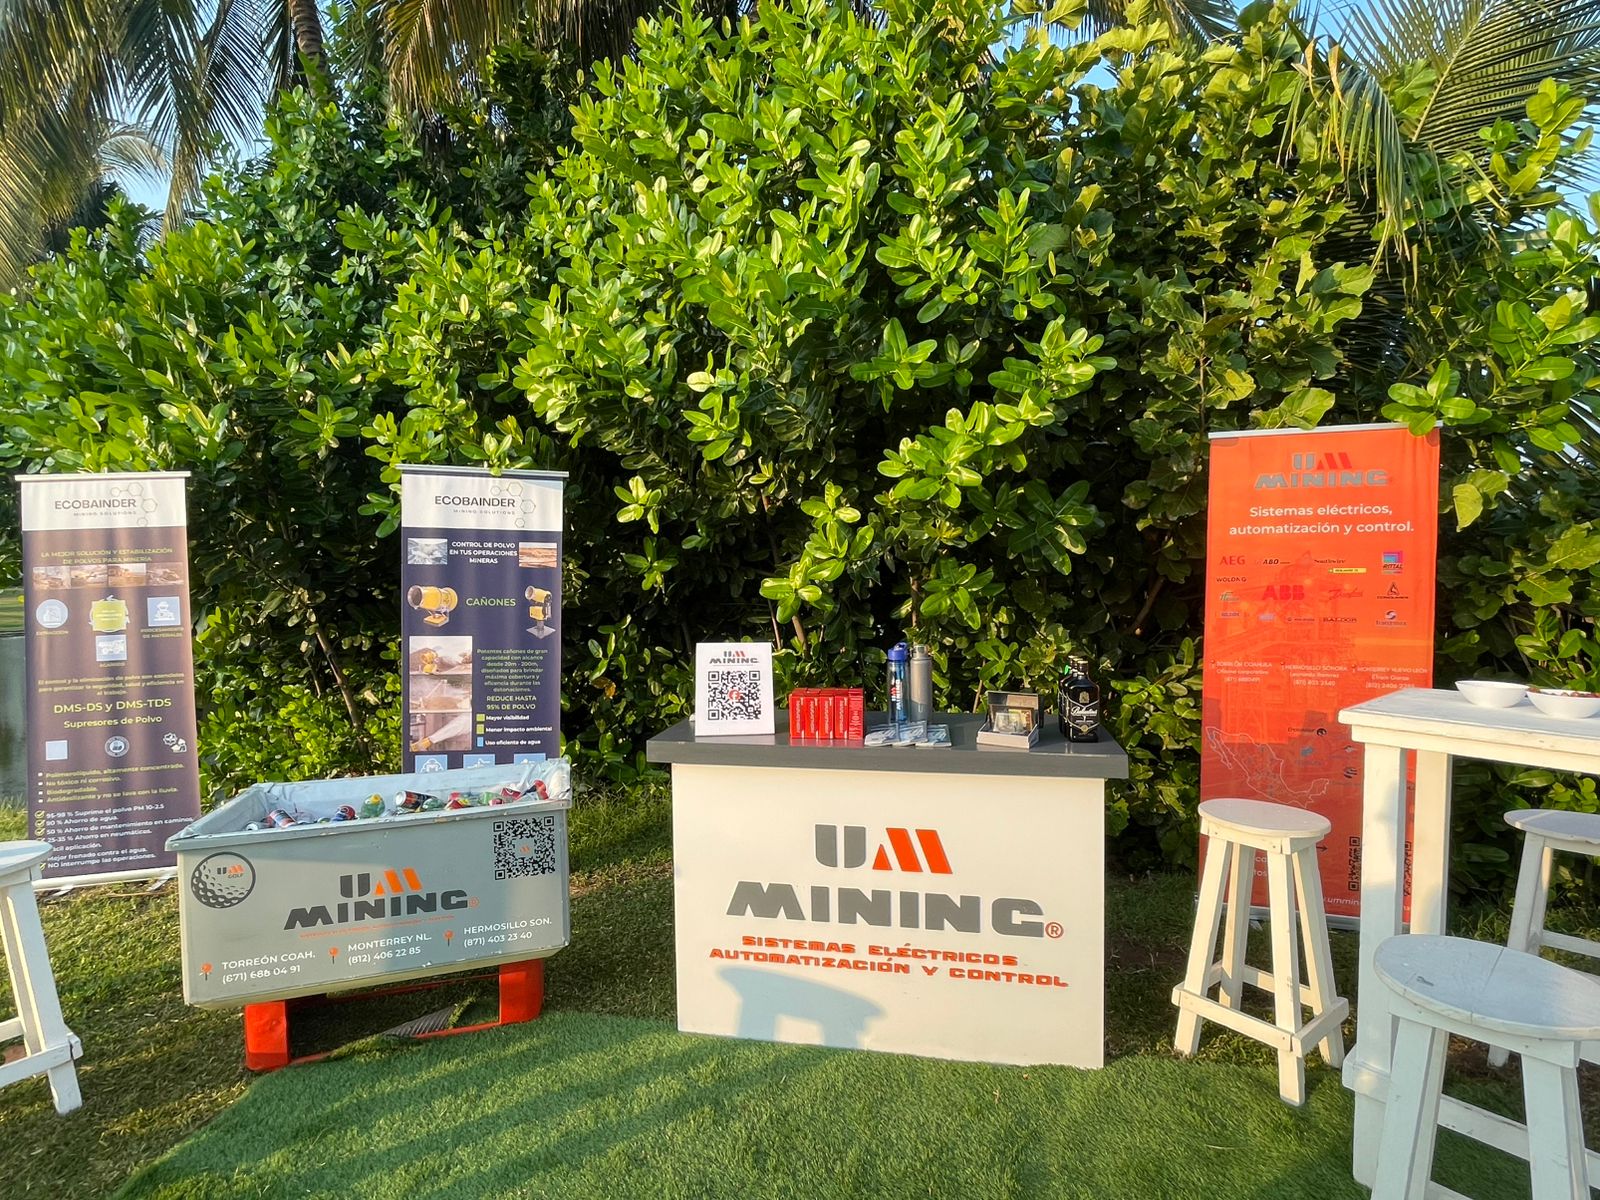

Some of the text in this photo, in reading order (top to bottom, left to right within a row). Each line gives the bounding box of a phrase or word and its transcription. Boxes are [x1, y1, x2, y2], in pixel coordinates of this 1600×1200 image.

[1255, 470, 1388, 489] MINING
[55, 498, 137, 510] ECOBAINDER
[435, 496, 515, 508] ECOBAINDER
[1250, 503, 1392, 517] Sistemas eléctricos,
[1229, 521, 1414, 535] automatización y control.
[1220, 555, 1246, 565] AEG
[1261, 585, 1305, 600] ABB
[466, 597, 516, 606] CAÑONES
[54, 698, 172, 714] DMS-DS y DMS-TDS
[64, 715, 162, 729] Supresores de Polvo
[75, 810, 104, 818] Suprime
[100, 821, 153, 830] mantenimiento
[110, 829, 152, 837] neumáticos.
[65, 843, 102, 852] aplicación.
[60, 858, 100, 867] interrumpe
[112, 853, 156, 862] operaciones.
[68, 851, 96, 860] frenado
[283, 890, 468, 930] MINING
[726, 880, 1044, 939] MINING
[464, 920, 527, 934] HERMOSILLO
[530, 917, 552, 926] SON.
[348, 933, 432, 952] MONTERREY NL.
[464, 931, 532, 948] (871) 403 23 40
[348, 946, 421, 965] (812) 406 22 85
[741, 935, 1019, 967] SISTEMAS ELÉCTRICOS
[222, 950, 316, 970] TORREÓN COAH.
[273, 967, 288, 976] 04
[290, 965, 301, 974] 91
[709, 948, 1070, 988] AUTOMATIZACIÓN Y CONTROL
